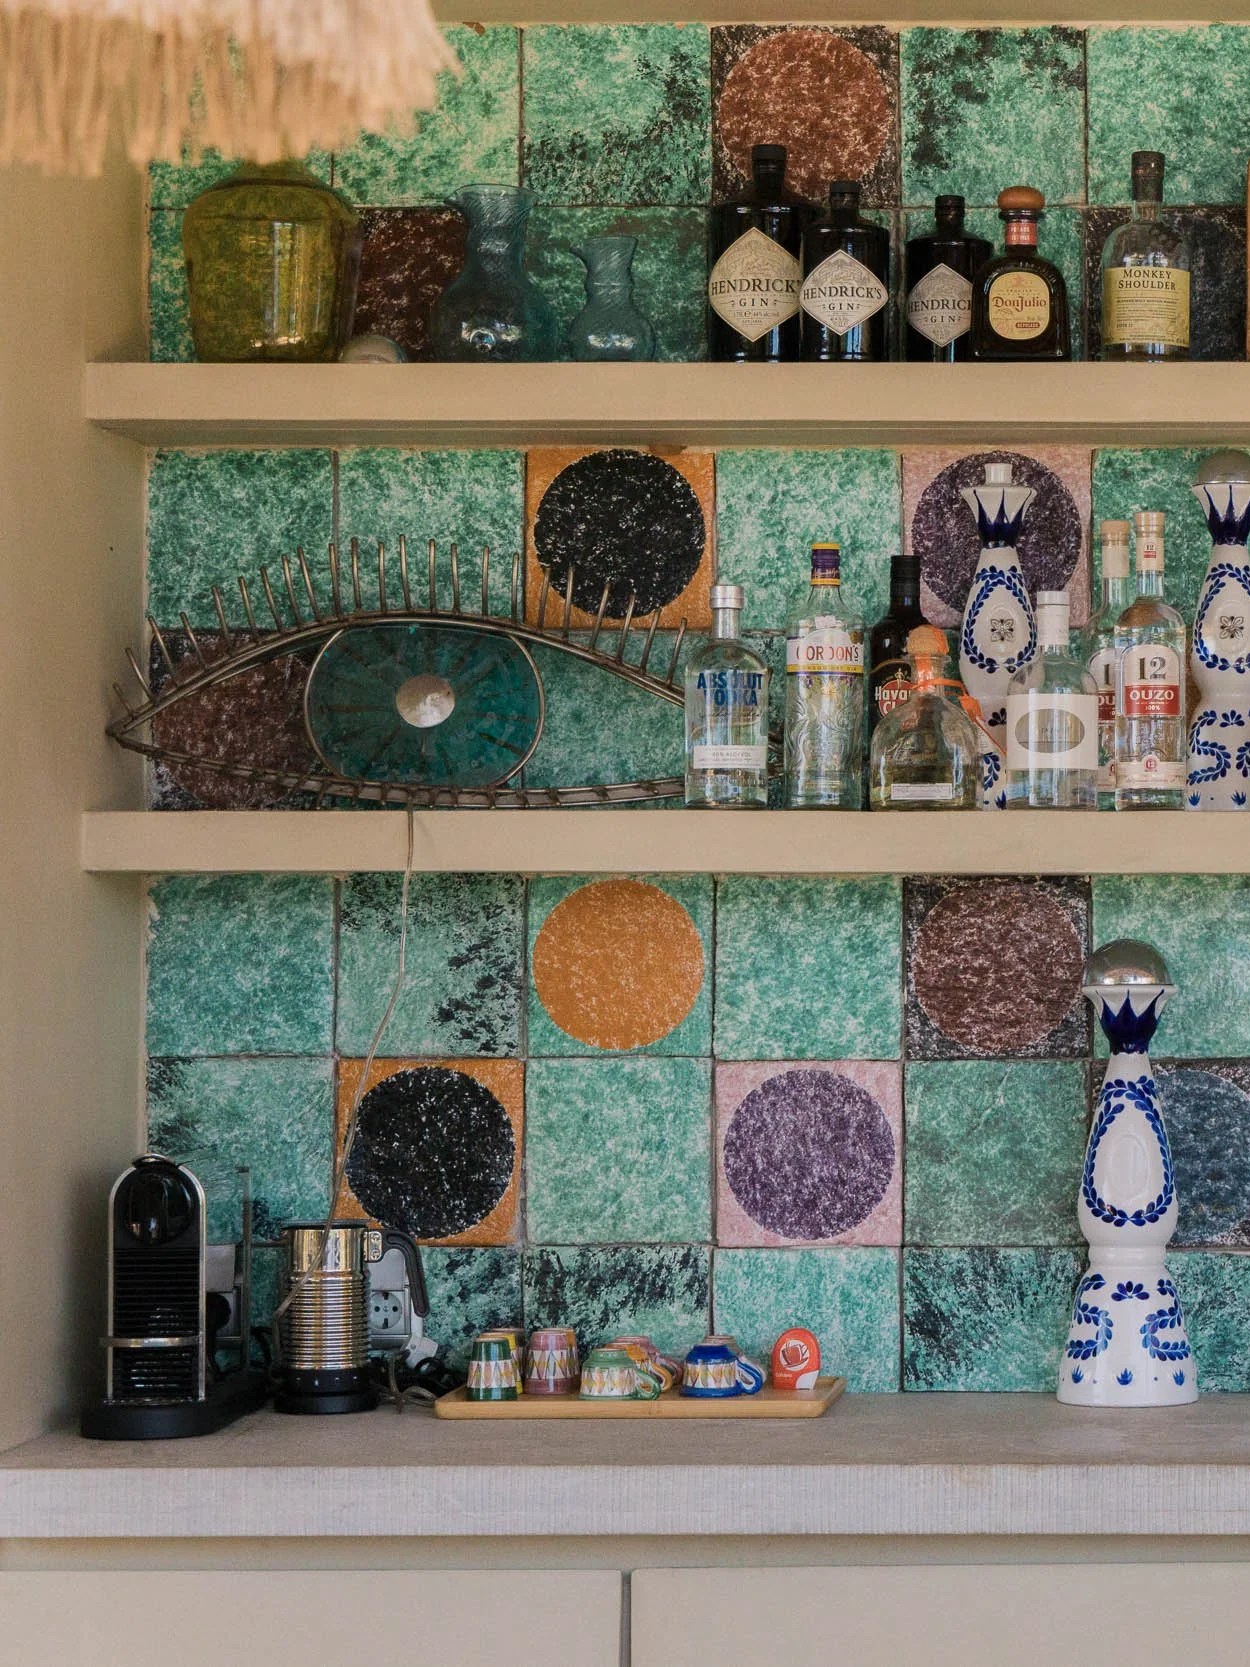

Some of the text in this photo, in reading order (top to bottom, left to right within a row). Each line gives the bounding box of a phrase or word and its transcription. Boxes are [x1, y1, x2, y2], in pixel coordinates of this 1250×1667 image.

[1123, 269, 1172, 280] MONKEY
[1118, 280, 1176, 290] SHOULDER
[803, 285, 882, 301] HENDRICK'S
[739, 298, 768, 307] GIN
[828, 303, 854, 311] GIN
[930, 315, 956, 323] GIN
[1138, 656, 1167, 681] 12
[1129, 689, 1175, 702] OUZO
